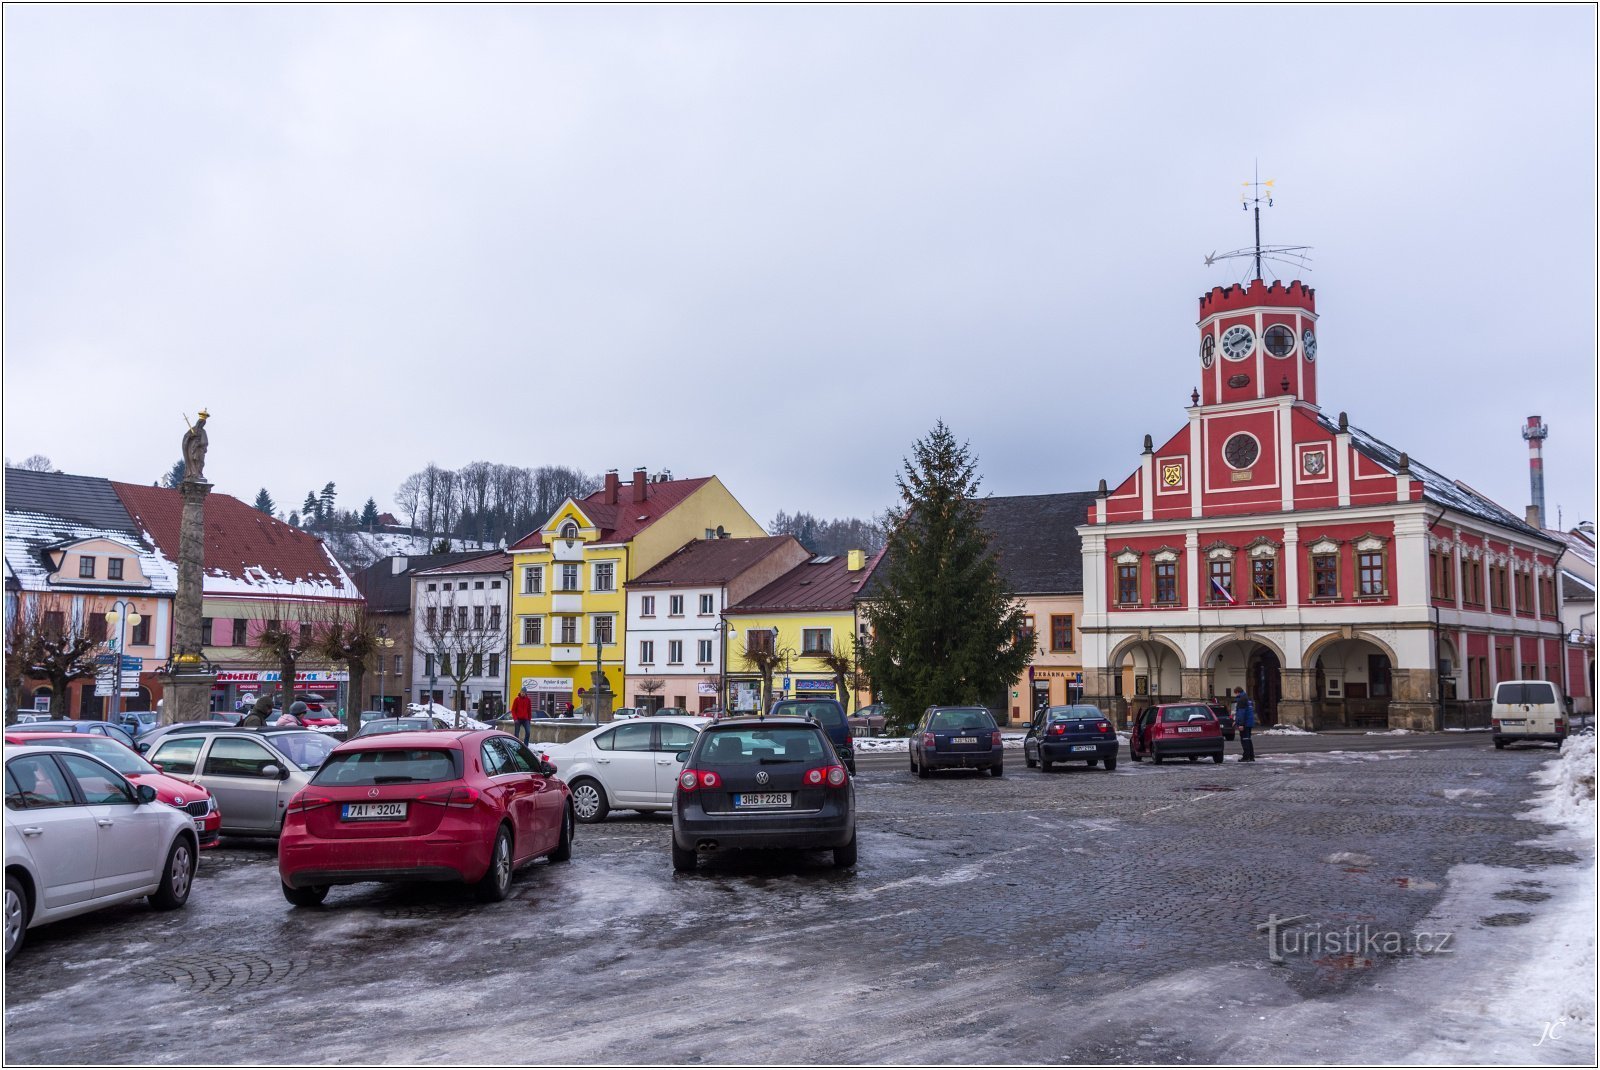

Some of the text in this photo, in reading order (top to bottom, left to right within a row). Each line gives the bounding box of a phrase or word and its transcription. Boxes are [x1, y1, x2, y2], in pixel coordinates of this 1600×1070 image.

[742, 793, 787, 804] 3H6 2268
[351, 804, 402, 816] 7AI 3204
